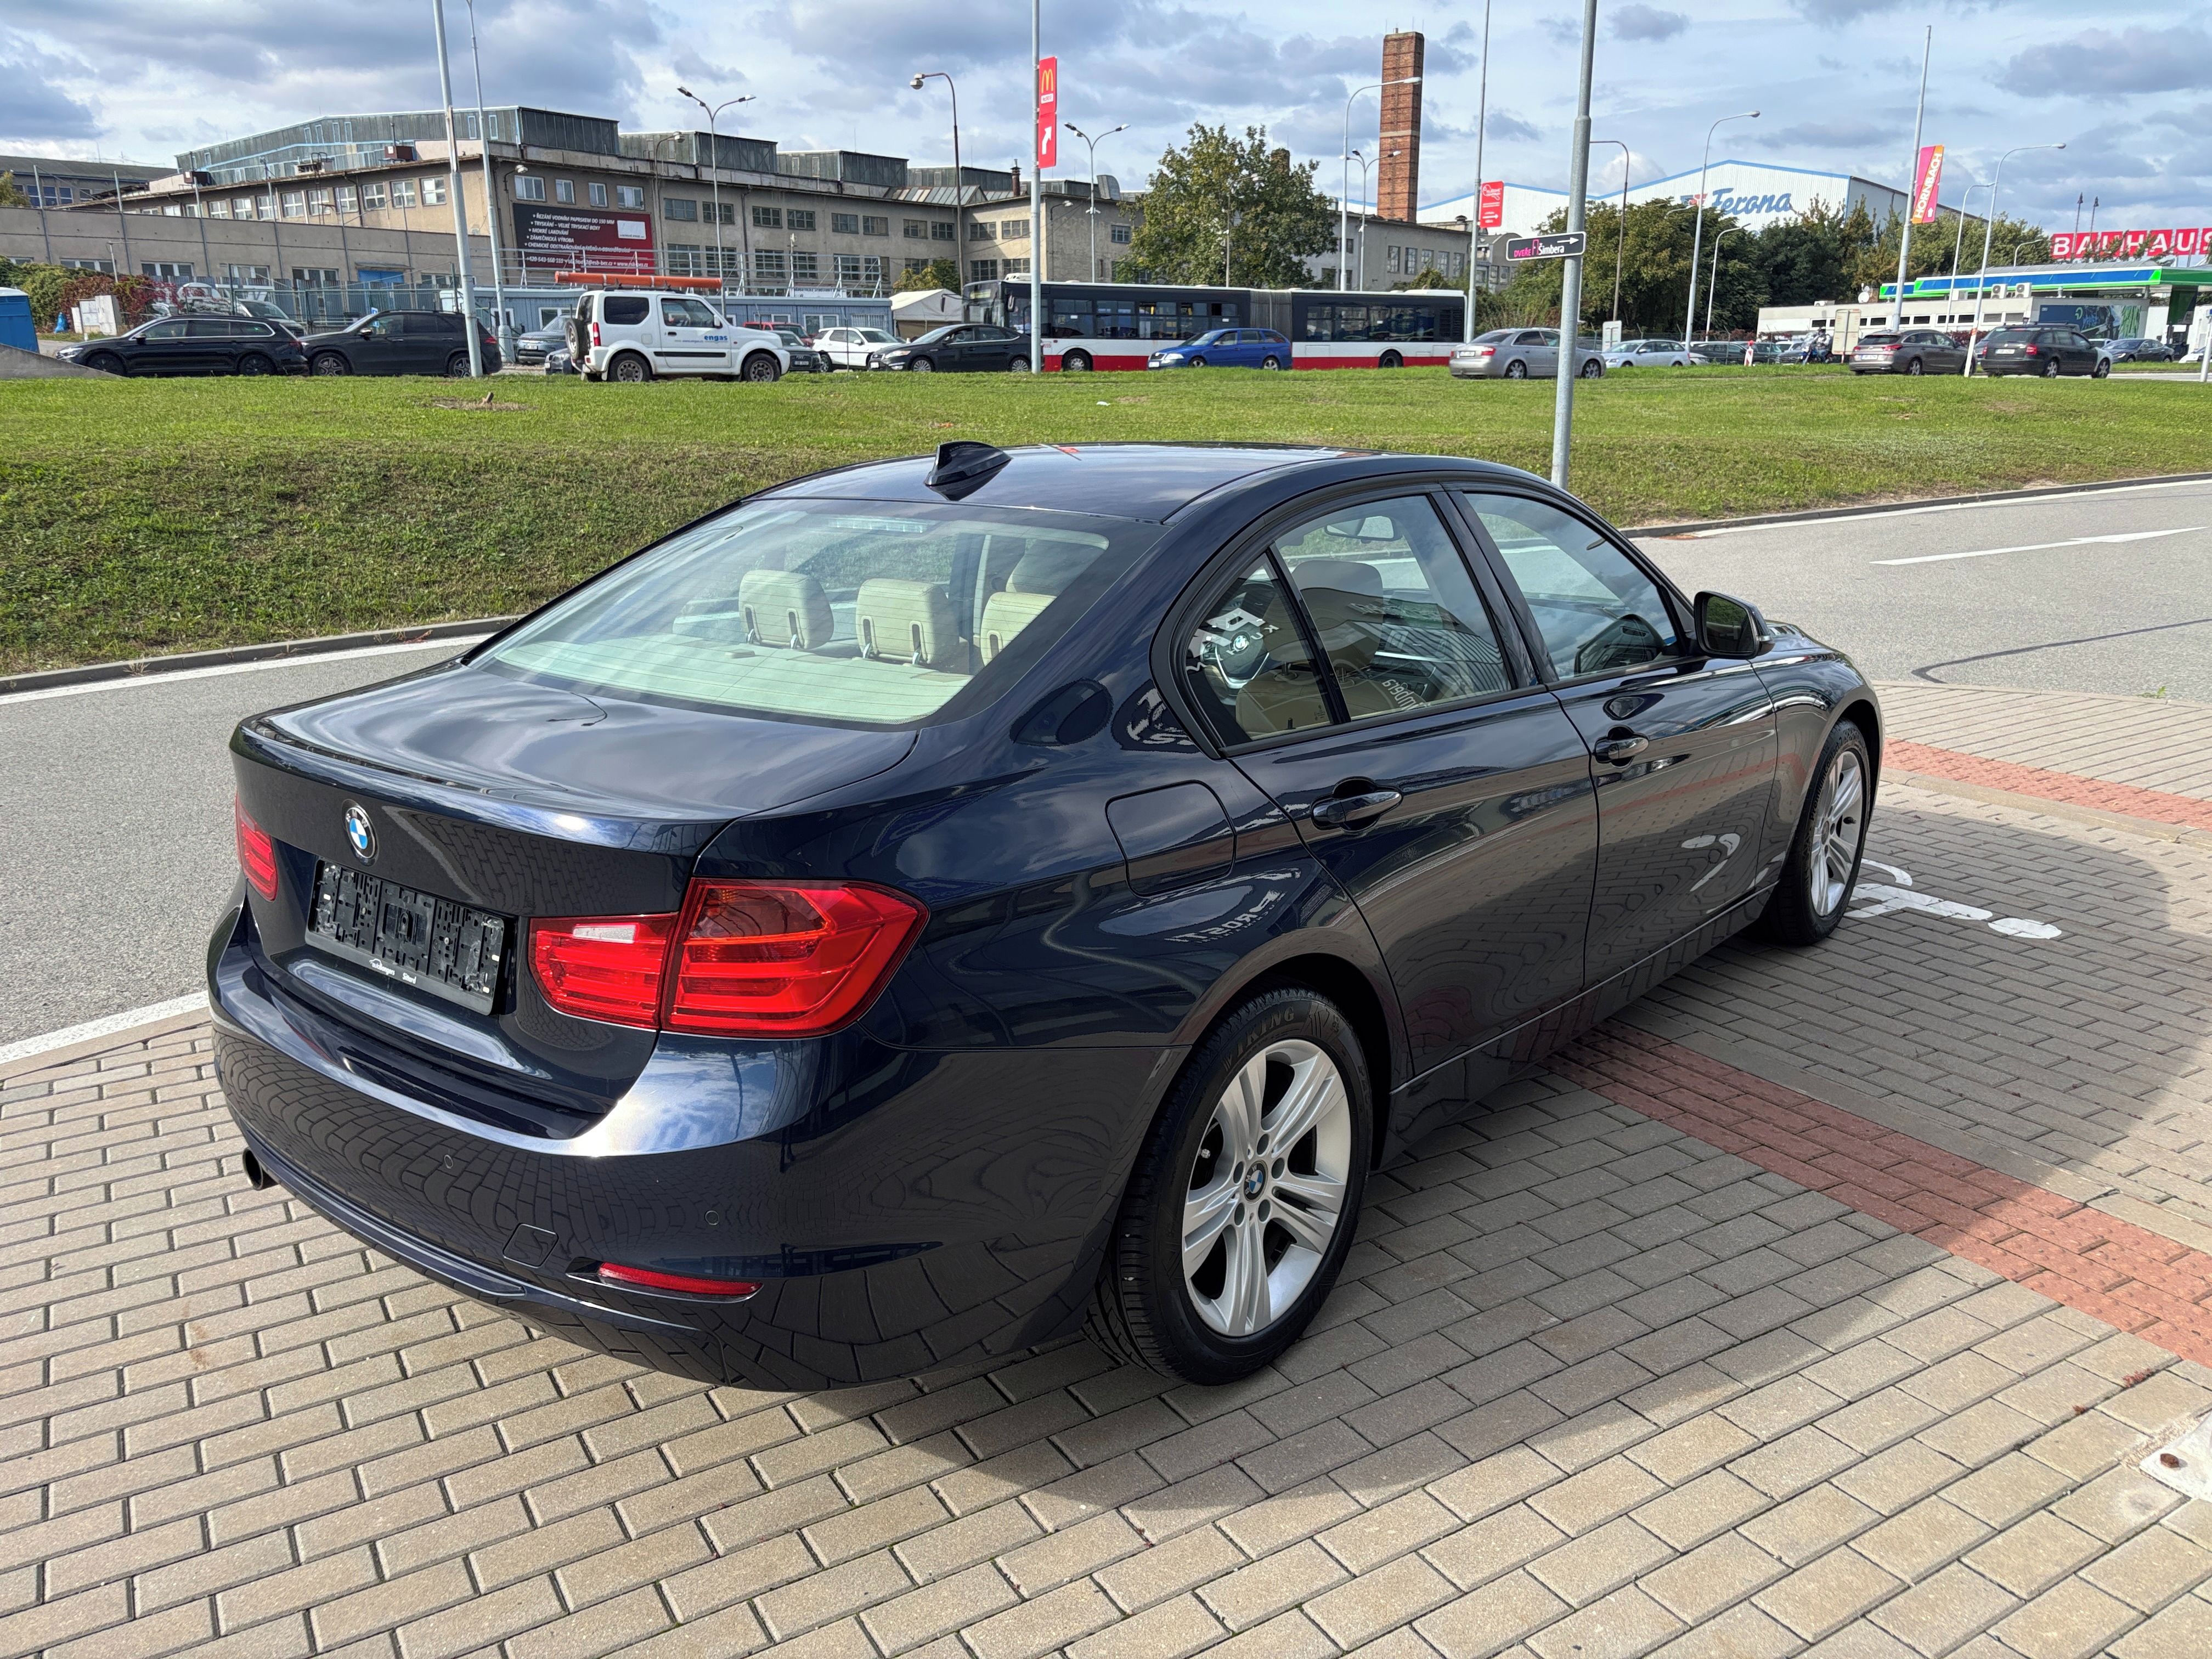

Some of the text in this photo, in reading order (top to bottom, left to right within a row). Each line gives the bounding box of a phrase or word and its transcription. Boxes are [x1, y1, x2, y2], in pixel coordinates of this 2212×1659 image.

[1914, 153, 1942, 218] HORNBACH
[1712, 188, 1791, 215] Ferona
[1514, 243, 1564, 257] DVEŘE Šimbera
[346, 809, 368, 828] BMW
[1222, 1006, 1295, 1071] VIKING
[1245, 1164, 1257, 1195] BMW
